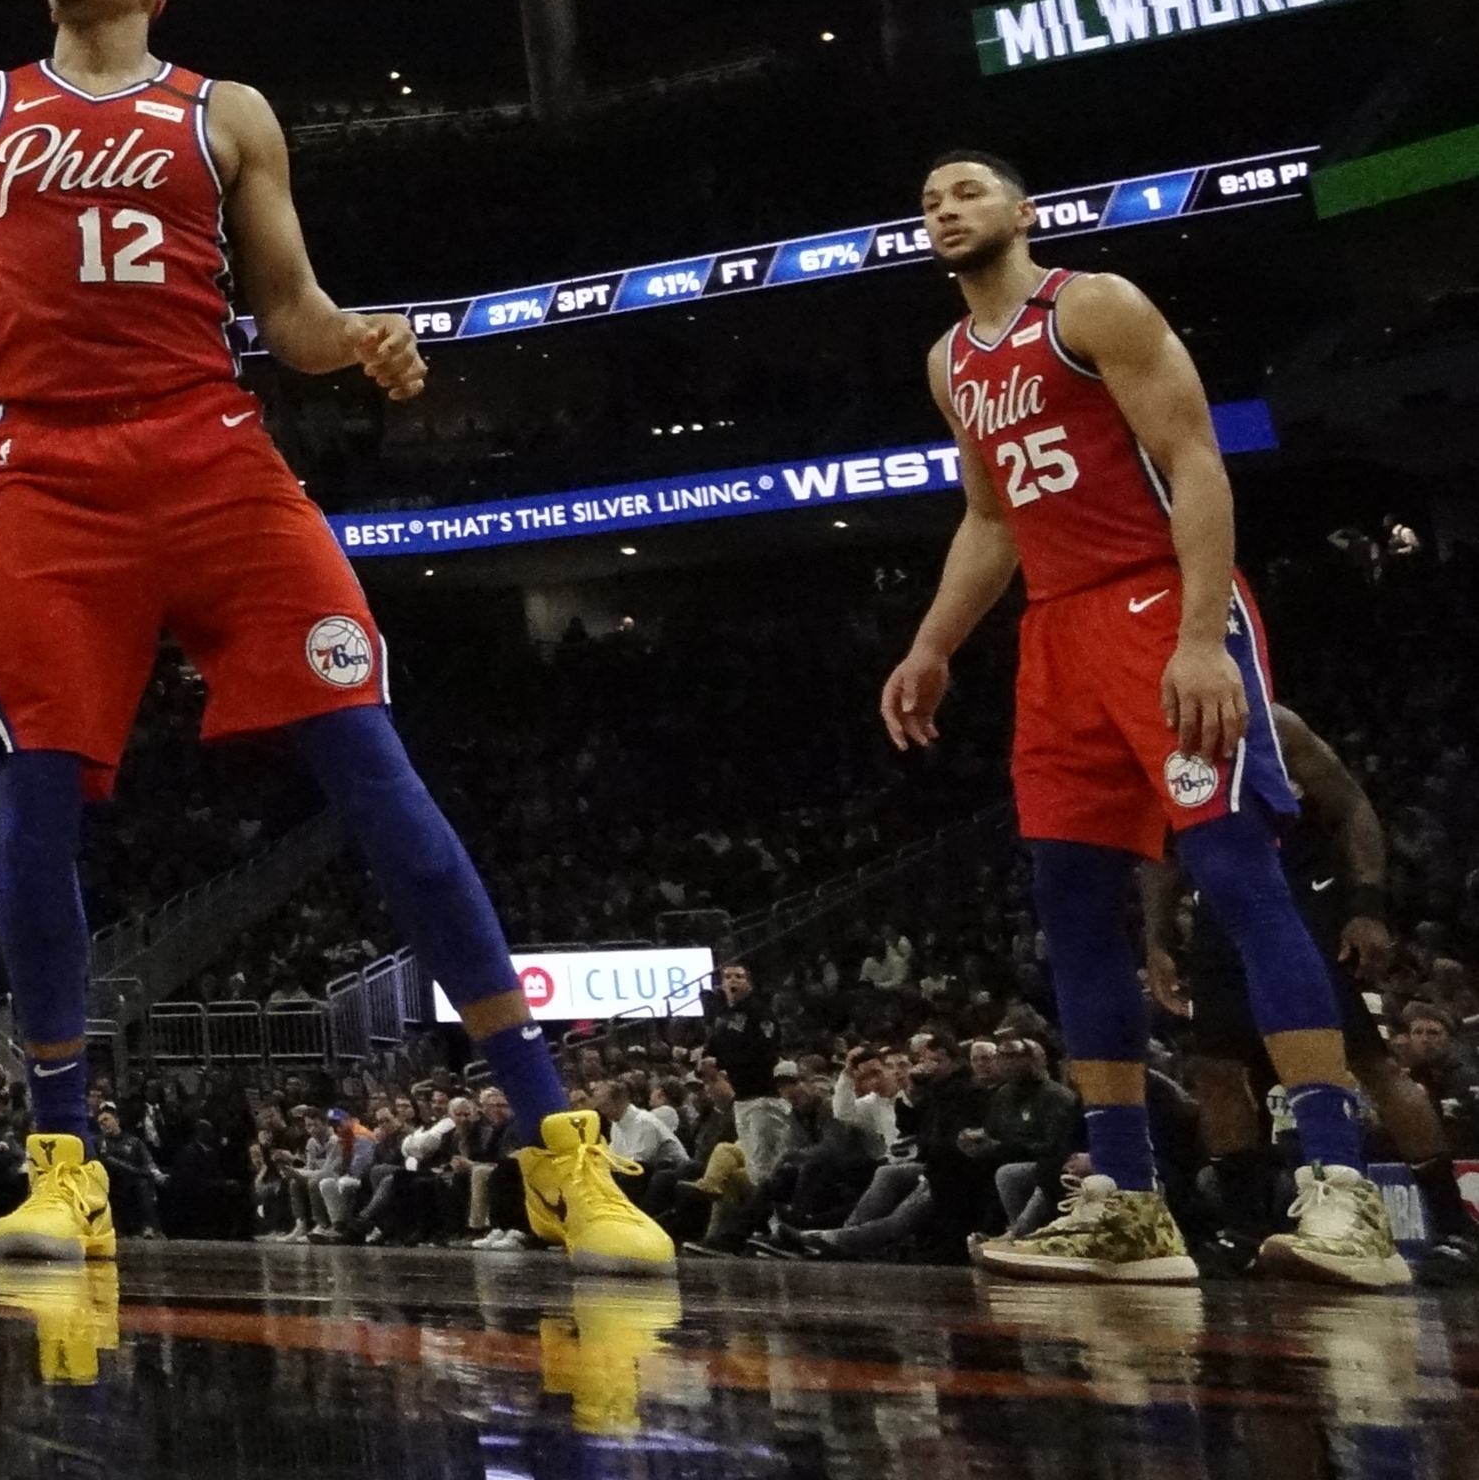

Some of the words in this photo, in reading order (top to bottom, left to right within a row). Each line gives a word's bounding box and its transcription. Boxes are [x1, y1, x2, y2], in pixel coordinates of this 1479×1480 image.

[77, 206, 166, 284] 12
[413, 311, 453, 336] FG
[487, 298, 544, 327] 37%
[556, 283, 611, 313] 3PT
[645, 269, 702, 297] 41%
[720, 257, 759, 285] FT
[798, 241, 861, 273] 67%
[876, 228, 933, 257] FLS
[1037, 198, 1100, 230] TOL
[1142, 187, 1162, 211] 1
[1218, 167, 1277, 196] 9:18
[953, 363, 1047, 442] Phila
[426, 510, 515, 542] THAT'S
[515, 502, 568, 531] THE
[572, 493, 652, 524] SILVER
[782, 446, 961, 502] WEST
[995, 424, 1080, 509] 25
[585, 966, 691, 1002] CLUB
